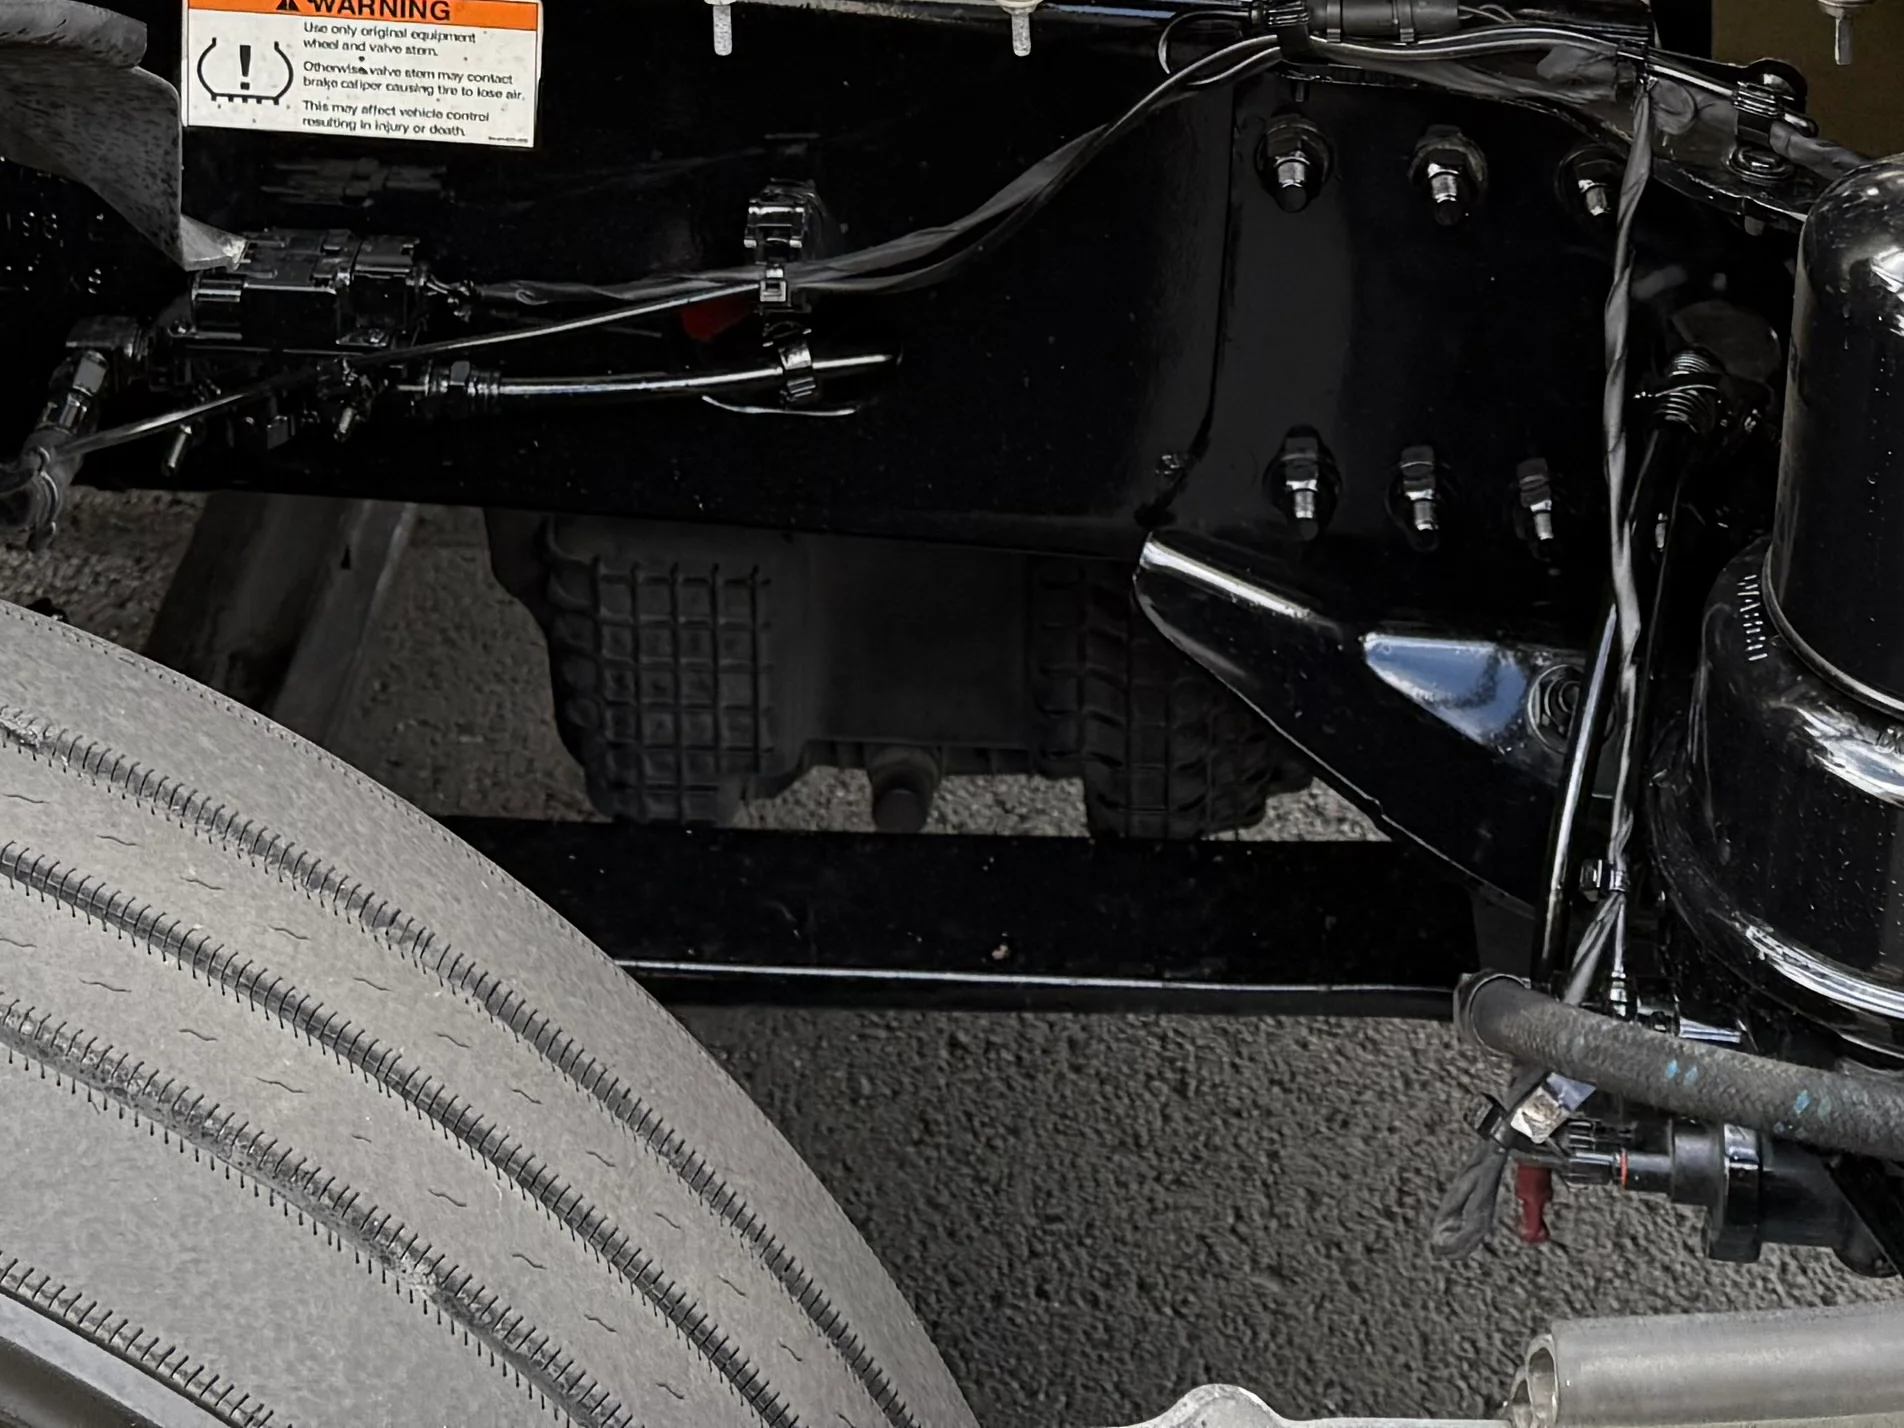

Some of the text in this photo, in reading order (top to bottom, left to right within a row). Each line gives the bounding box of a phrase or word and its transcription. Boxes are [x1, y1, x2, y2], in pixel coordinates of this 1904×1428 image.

[303, 21, 476, 45] Use only original equipment
[303, 38, 339, 51] wheel
[342, 40, 366, 52] and
[370, 42, 403, 55] valve
[303, 60, 514, 86] Otherwise valve stem may contact
[303, 75, 339, 92] brake
[340, 78, 383, 95] caliper
[385, 82, 435, 97] causing
[437, 84, 458, 97] tire
[461, 86, 474, 98] to
[476, 87, 504, 99] lose
[303, 99, 490, 123] This may affect vehicle control
[302, 116, 358, 132] resulting
[360, 119, 372, 130] in
[374, 120, 411, 136] injury
[412, 123, 427, 135] or
